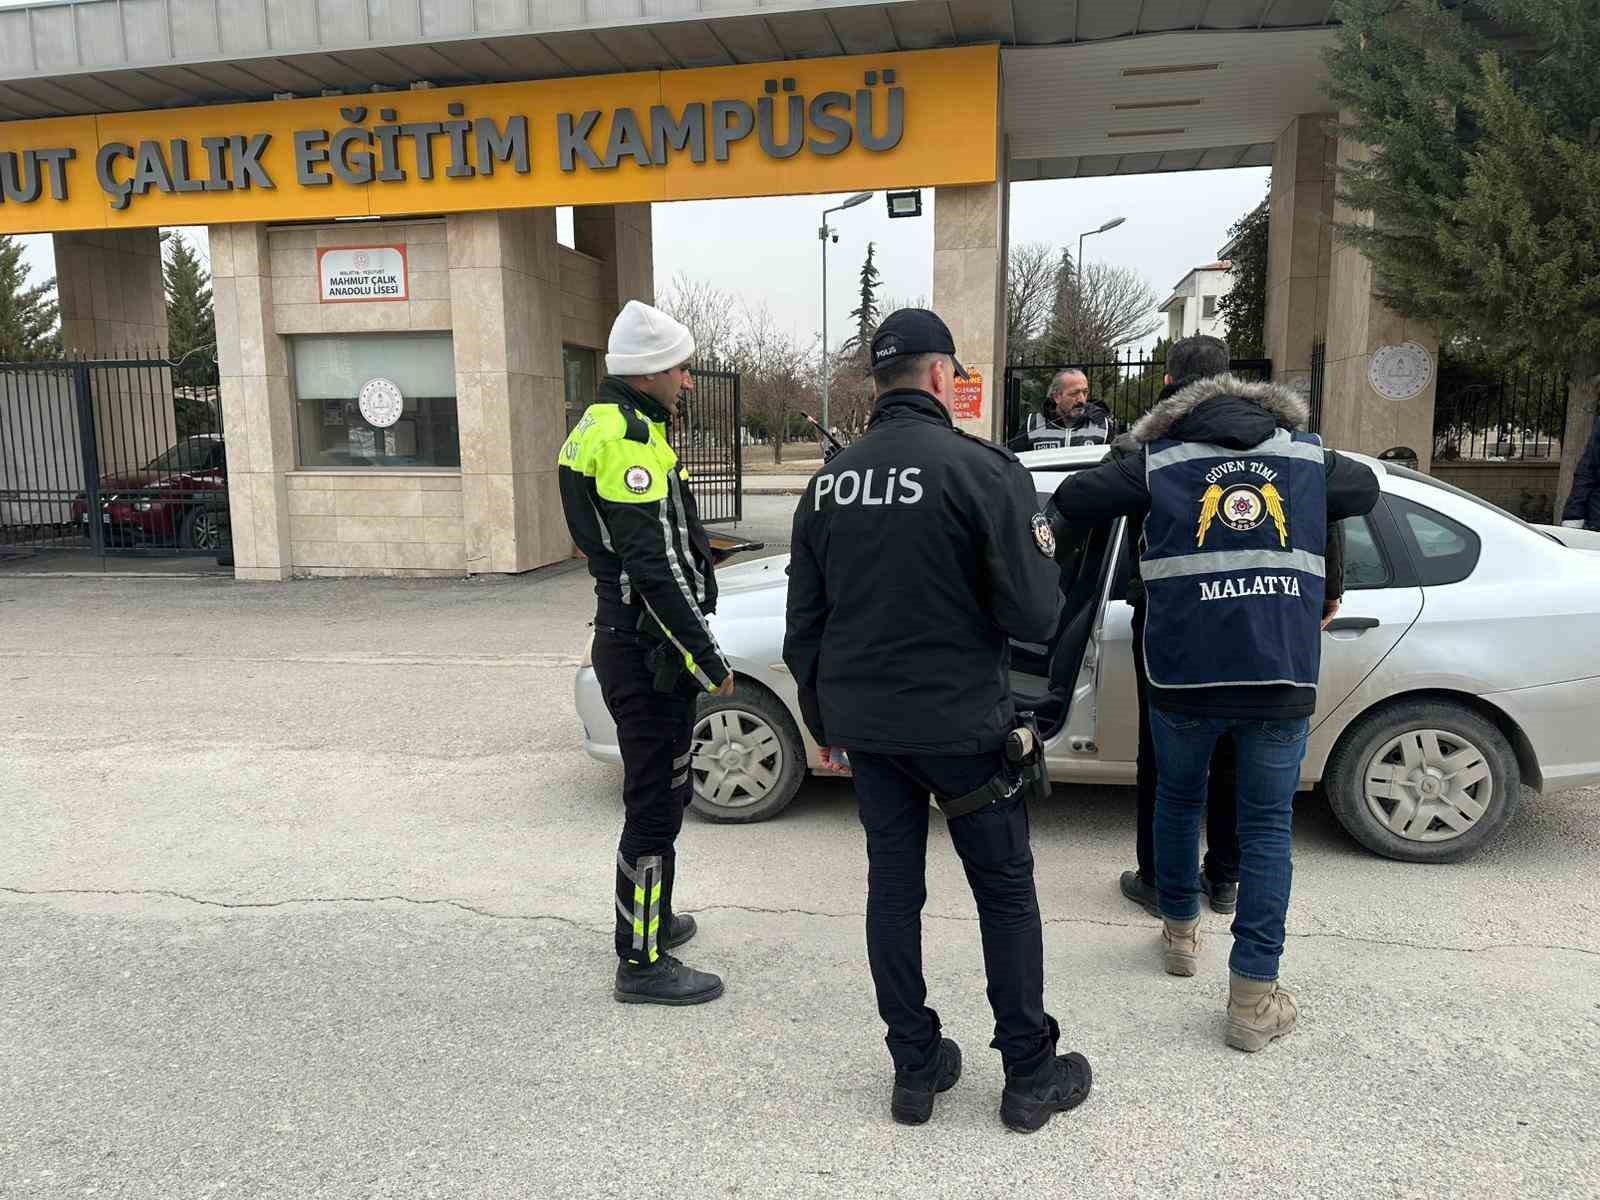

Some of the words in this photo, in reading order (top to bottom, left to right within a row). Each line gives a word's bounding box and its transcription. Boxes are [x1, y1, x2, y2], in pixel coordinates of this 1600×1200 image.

[0, 147, 76, 203] UT
[95, 133, 278, 210] ÇALIK
[294, 101, 531, 186] EĞİTİM
[557, 68, 905, 172] KAMPÜSÜ
[330, 276, 369, 286] MAHMUT
[371, 275, 397, 286] ÇALIK
[329, 286, 371, 296] ANADOLU
[373, 284, 399, 295] LİSESİ
[1200, 575, 1301, 600] MALATYA
